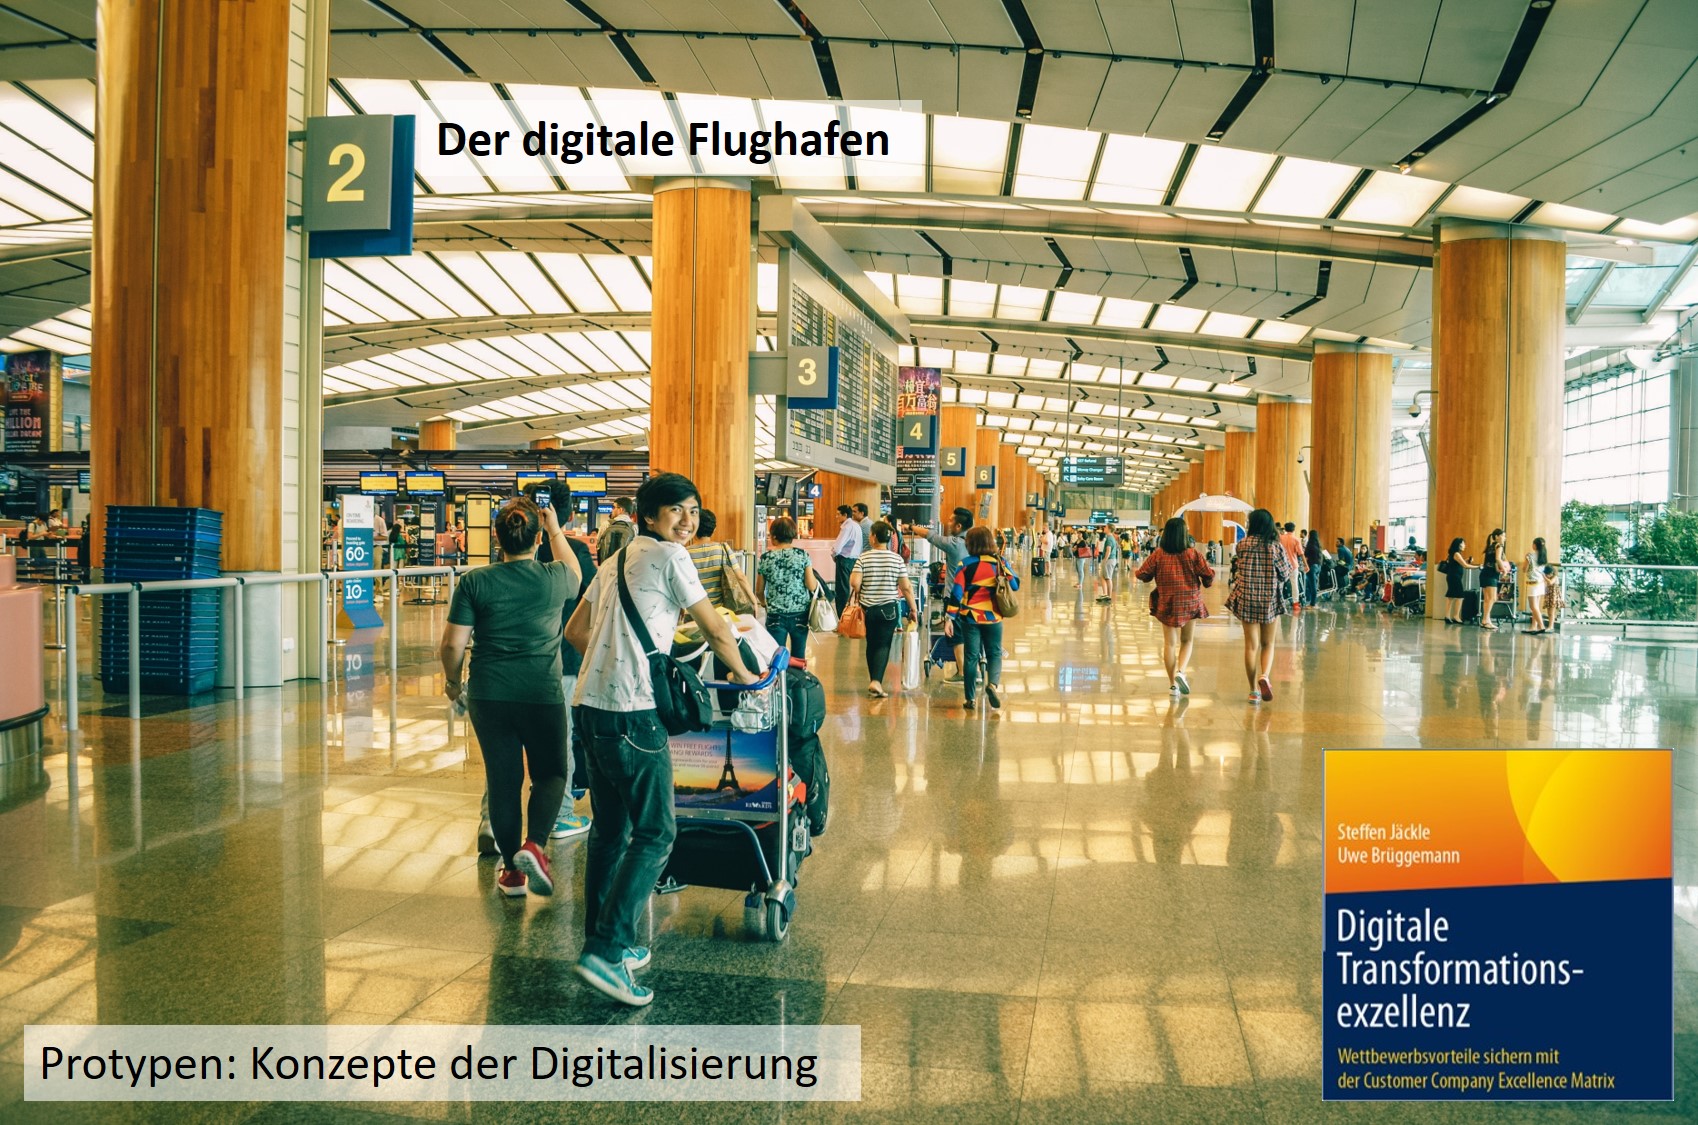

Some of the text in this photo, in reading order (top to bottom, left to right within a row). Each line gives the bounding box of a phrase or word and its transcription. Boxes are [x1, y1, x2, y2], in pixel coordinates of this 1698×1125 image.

[326, 143, 367, 202] 2
[798, 358, 817, 386] 3
[910, 422, 923, 441] 4
[946, 452, 956, 466] 5
[980, 470, 987, 480] 6
[810, 486, 820, 496] 4
[346, 546, 364, 561] 60
[346, 584, 362, 600] 10
